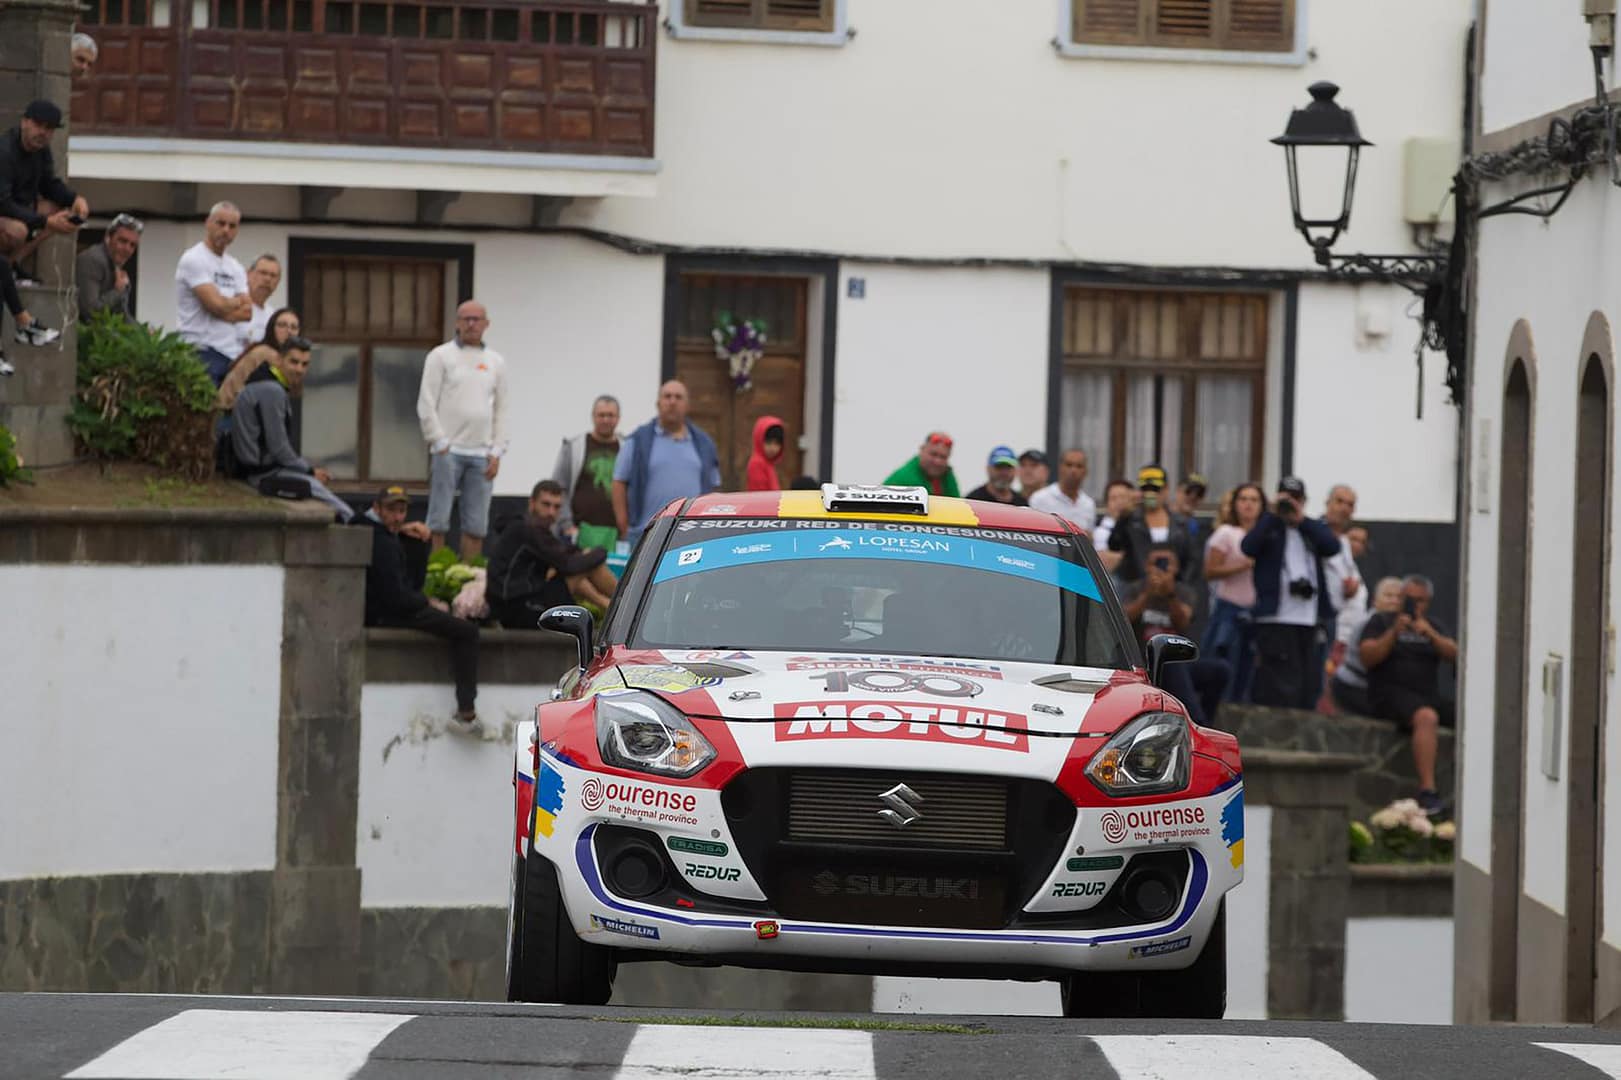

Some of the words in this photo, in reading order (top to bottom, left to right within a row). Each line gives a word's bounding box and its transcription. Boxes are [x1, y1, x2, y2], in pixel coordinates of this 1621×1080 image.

[850, 493, 921, 501] SUZUKI
[700, 519, 787, 529] SUZUKI
[796, 520, 840, 529] RED
[848, 522, 877, 530] DE
[884, 523, 1072, 548] CONCESIONARIOS
[859, 536, 950, 552] LOPESAN
[808, 671, 985, 698] 100
[787, 704, 1020, 745] MOTUL
[606, 784, 696, 811] ourense
[608, 804, 622, 813] the
[624, 806, 657, 819] thermal
[659, 814, 698, 825] province
[1127, 807, 1205, 828] ourense
[1134, 831, 1148, 840] the
[1149, 828, 1179, 839] thermal
[1180, 827, 1211, 838] province
[685, 863, 741, 881] REDUR
[847, 874, 979, 899] SUZUKI
[1052, 882, 1106, 897] REDUR
[606, 921, 655, 936] MICHELIN
